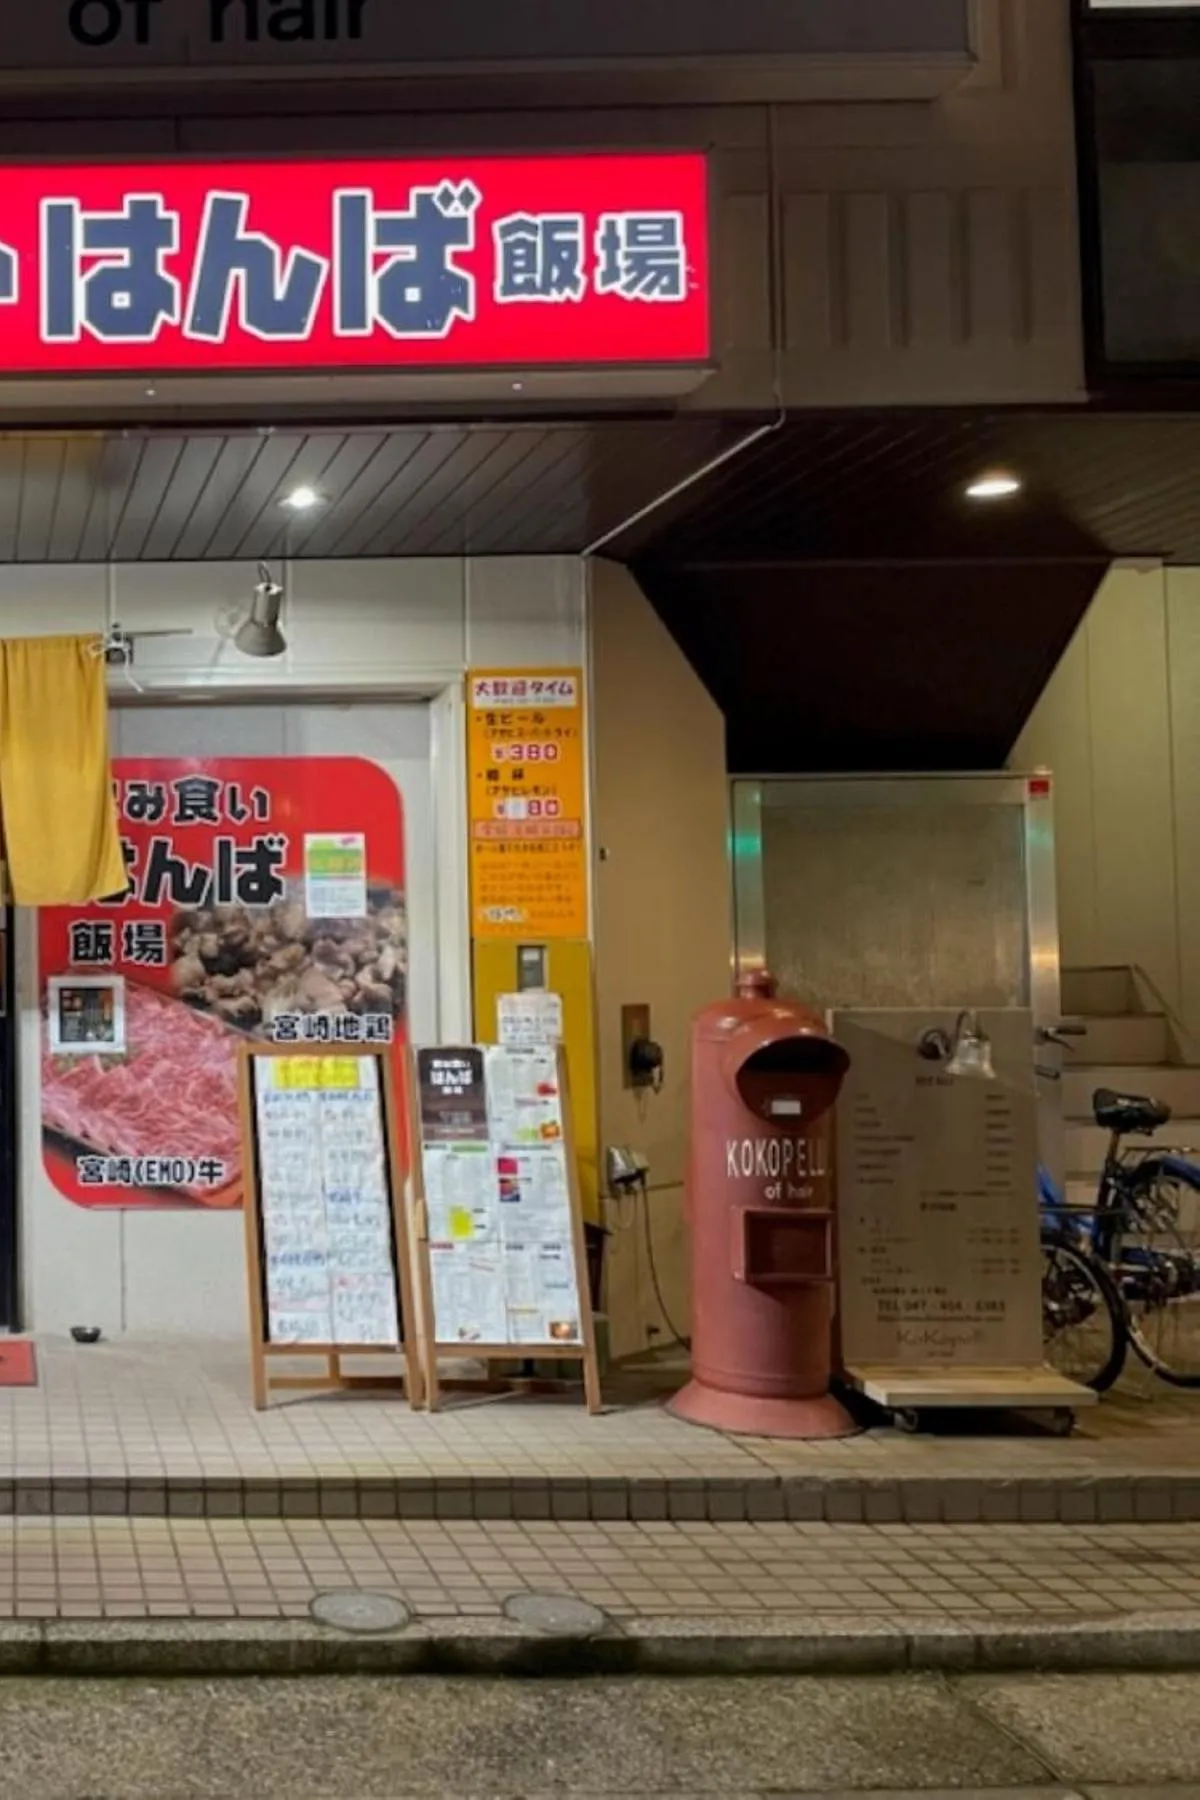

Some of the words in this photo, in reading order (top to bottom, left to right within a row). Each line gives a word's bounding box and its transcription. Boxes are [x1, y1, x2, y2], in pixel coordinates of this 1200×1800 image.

[40, 181, 482, 344] はんば
[494, 211, 688, 304] 飯場
[112, 776, 270, 824] み食い
[497, 799, 561, 818] ¥80
[70, 921, 167, 965] 飯場
[764, 1181, 783, 1200] of
